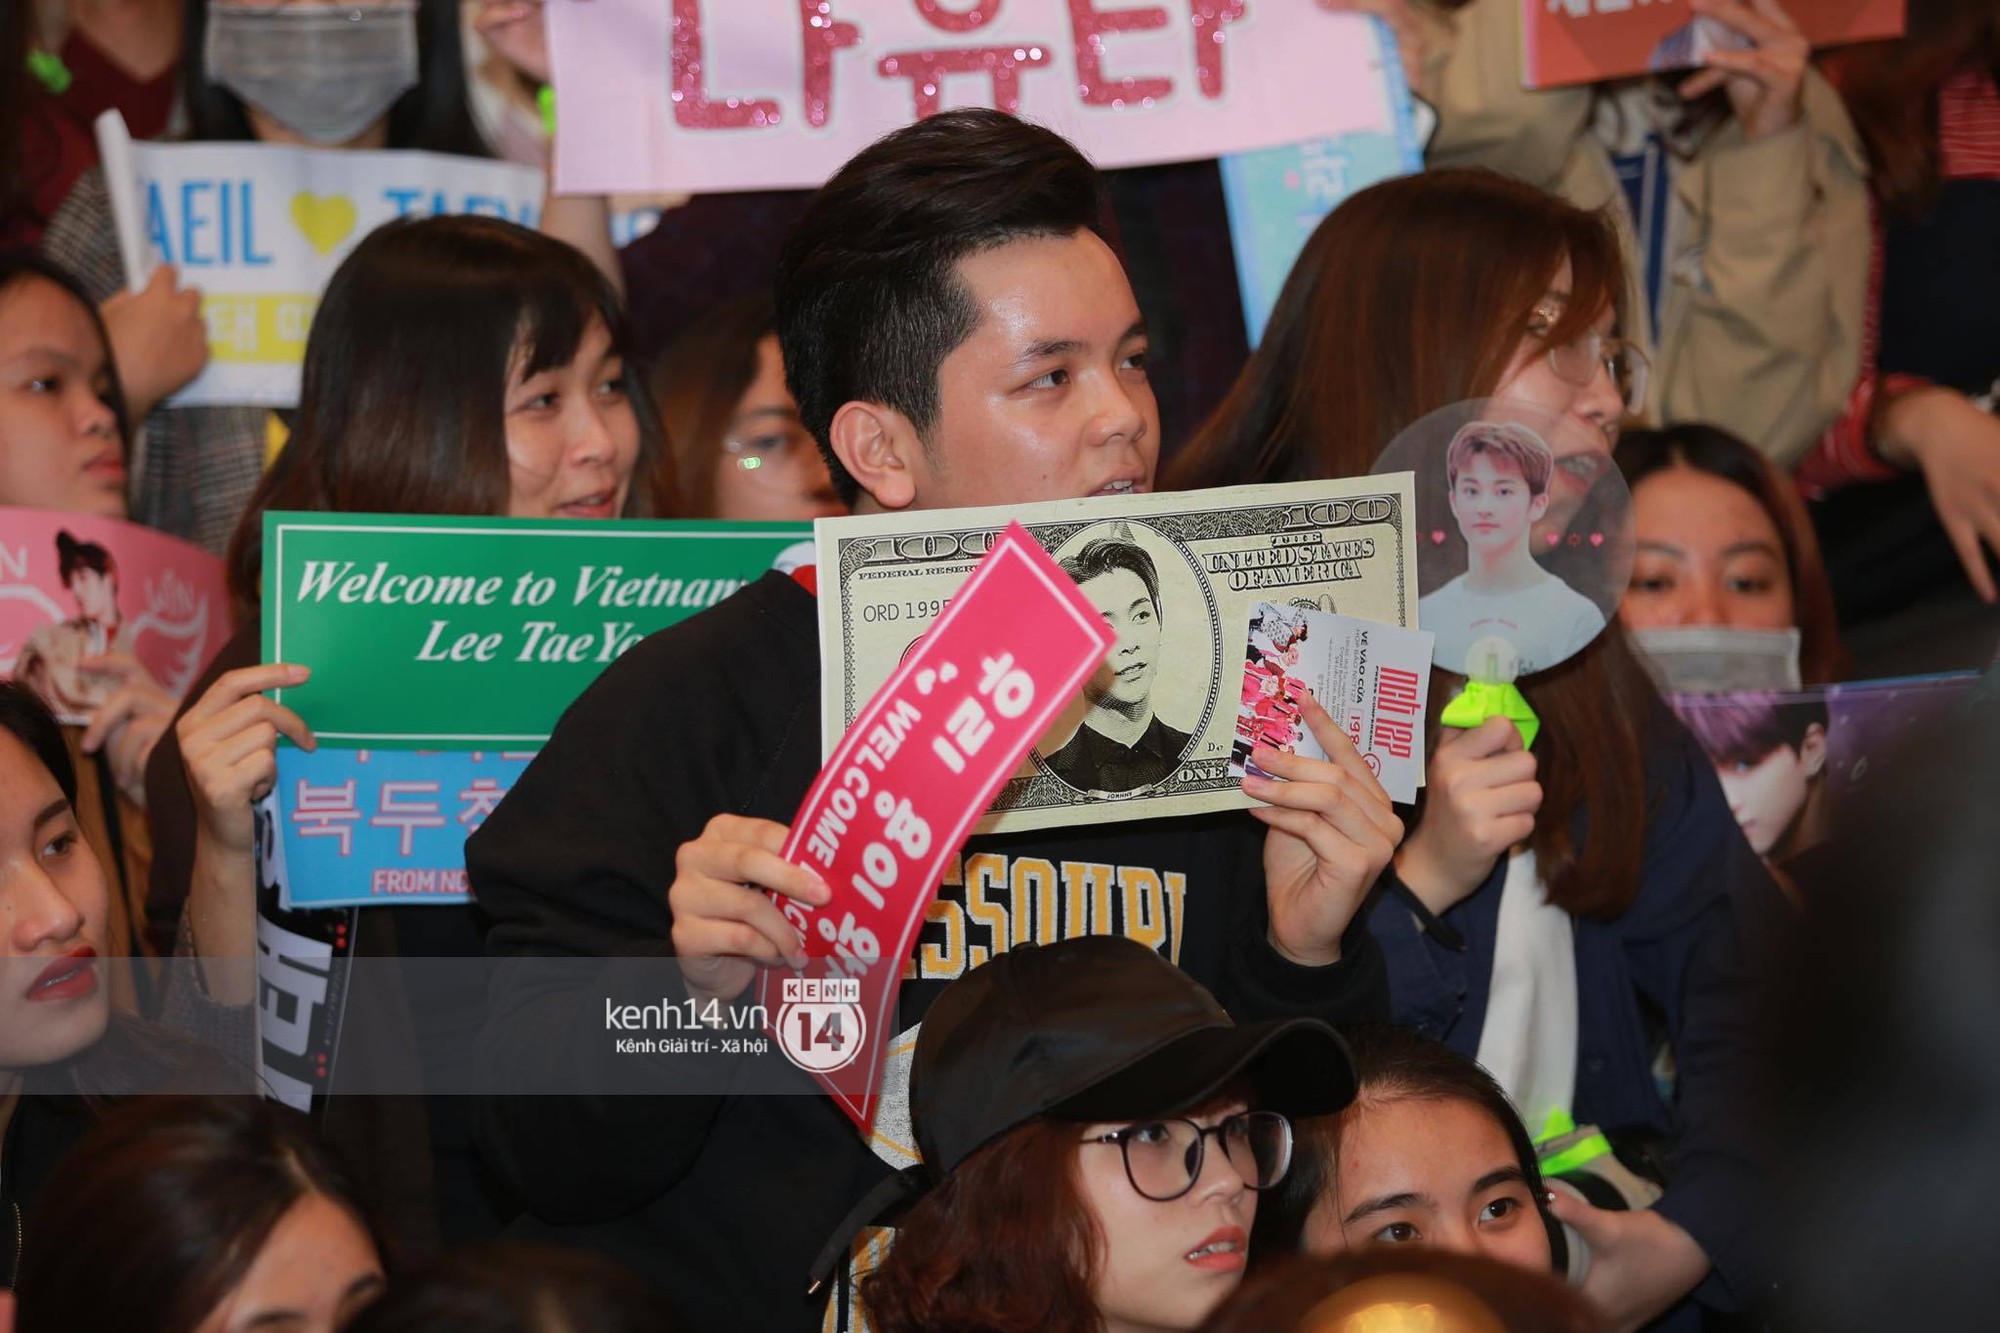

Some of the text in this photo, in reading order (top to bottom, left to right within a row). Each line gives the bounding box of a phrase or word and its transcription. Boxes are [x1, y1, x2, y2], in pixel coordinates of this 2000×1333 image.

[1282, 496, 1392, 529] 100
[1202, 538, 1375, 573] UNITED STATES
[1271, 532, 1322, 547] THE
[296, 560, 503, 605] Welcome
[511, 566, 556, 606] to
[858, 564, 979, 580] FEDERAL RESER
[1228, 560, 1362, 591] OF AMERICA
[863, 603, 899, 622] ORD
[416, 620, 502, 662] Lee
[931, 652, 1035, 774] 우리
[1374, 717, 1414, 758] 127
[806, 698, 922, 869] WELCOME
[1177, 766, 1224, 783] ONE
[851, 789, 933, 910] 용이
[372, 868, 435, 895] FROM
[902, 852, 1187, 979] SSOURI
